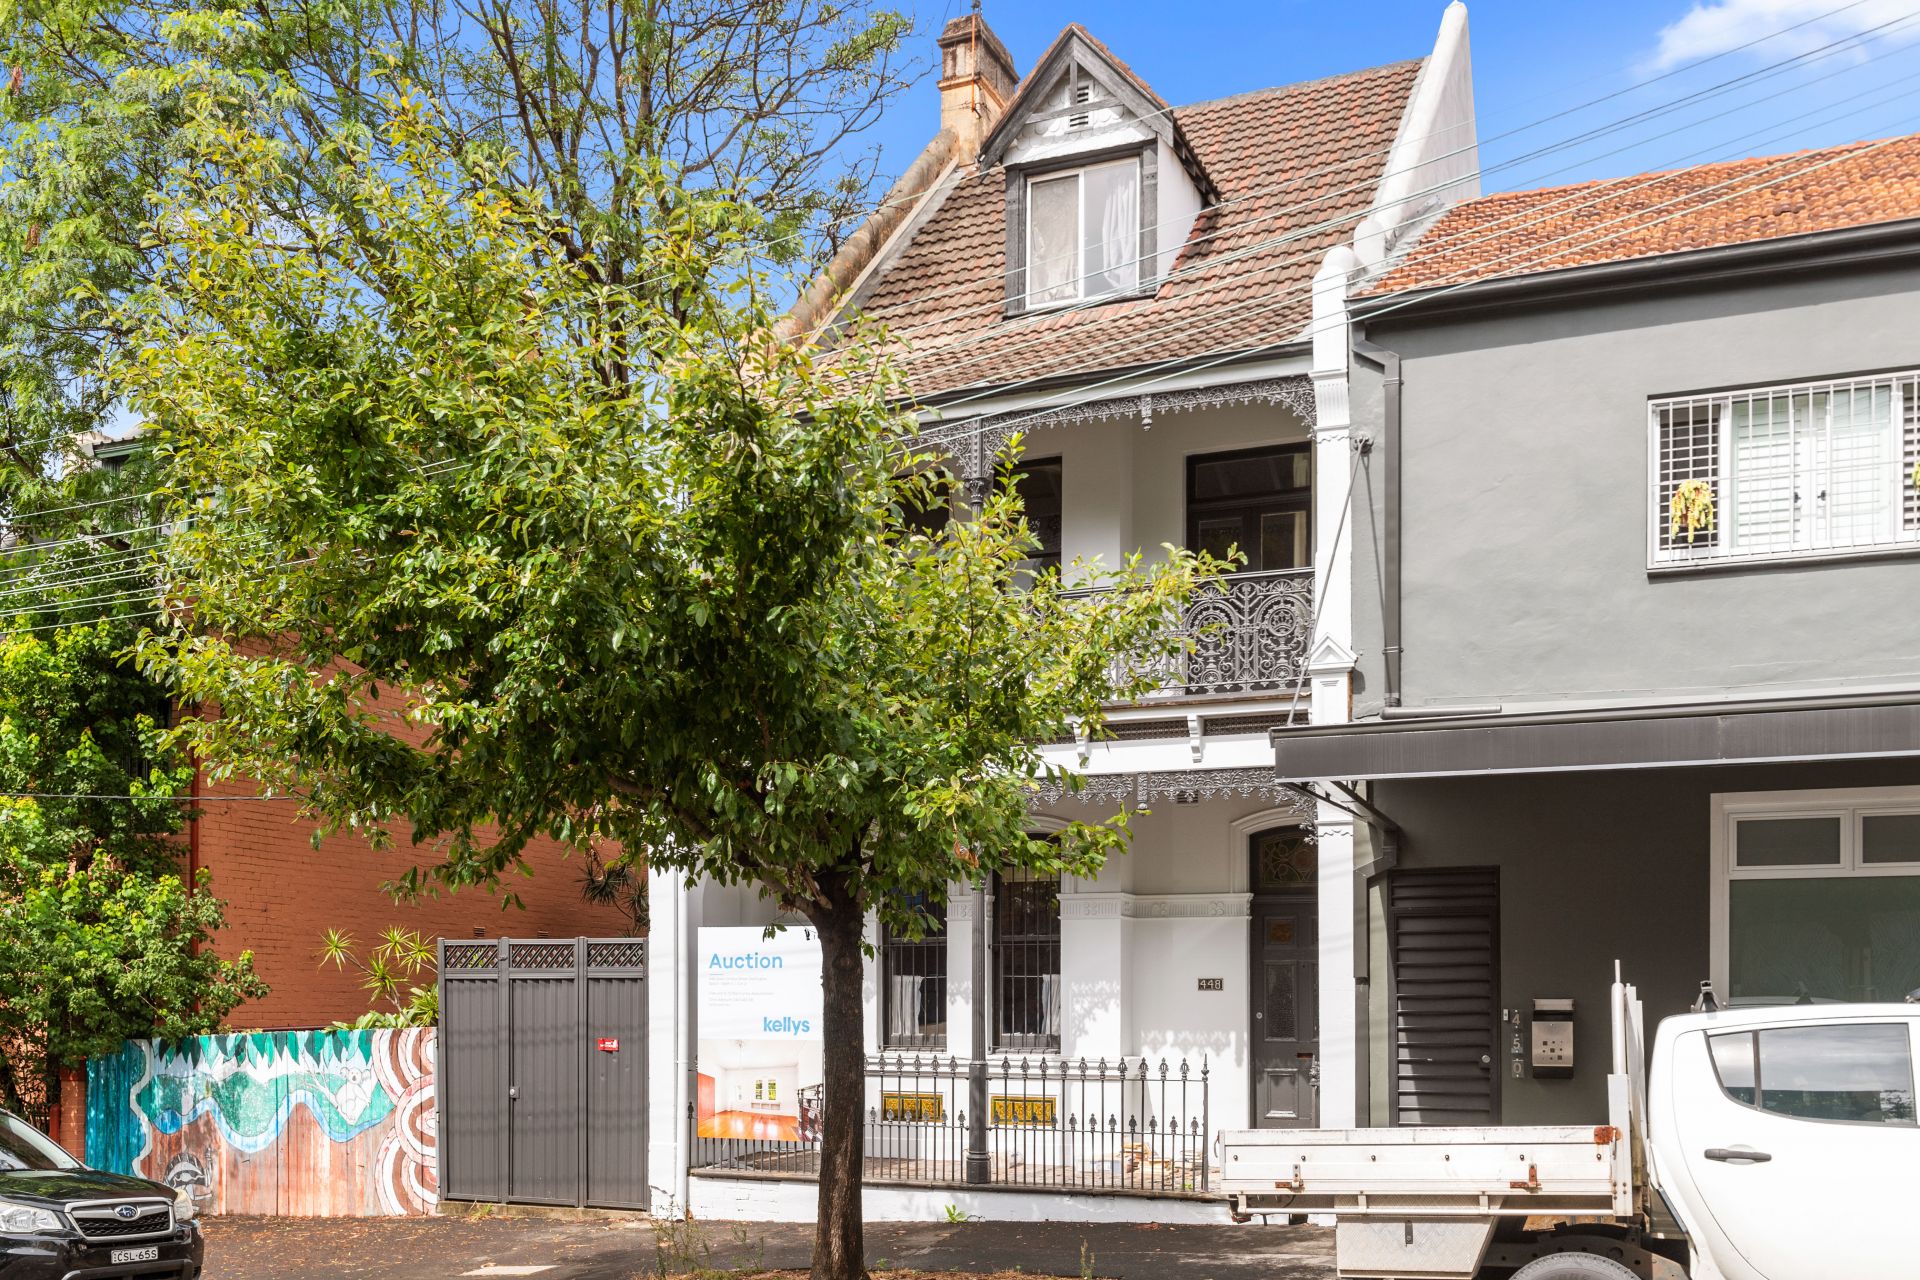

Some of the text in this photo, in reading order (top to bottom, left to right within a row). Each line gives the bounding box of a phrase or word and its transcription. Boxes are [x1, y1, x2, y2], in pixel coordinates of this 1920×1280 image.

[709, 952, 783, 969] Auction
[1200, 980, 1221, 990] 448
[763, 1016, 811, 1036] kellys
